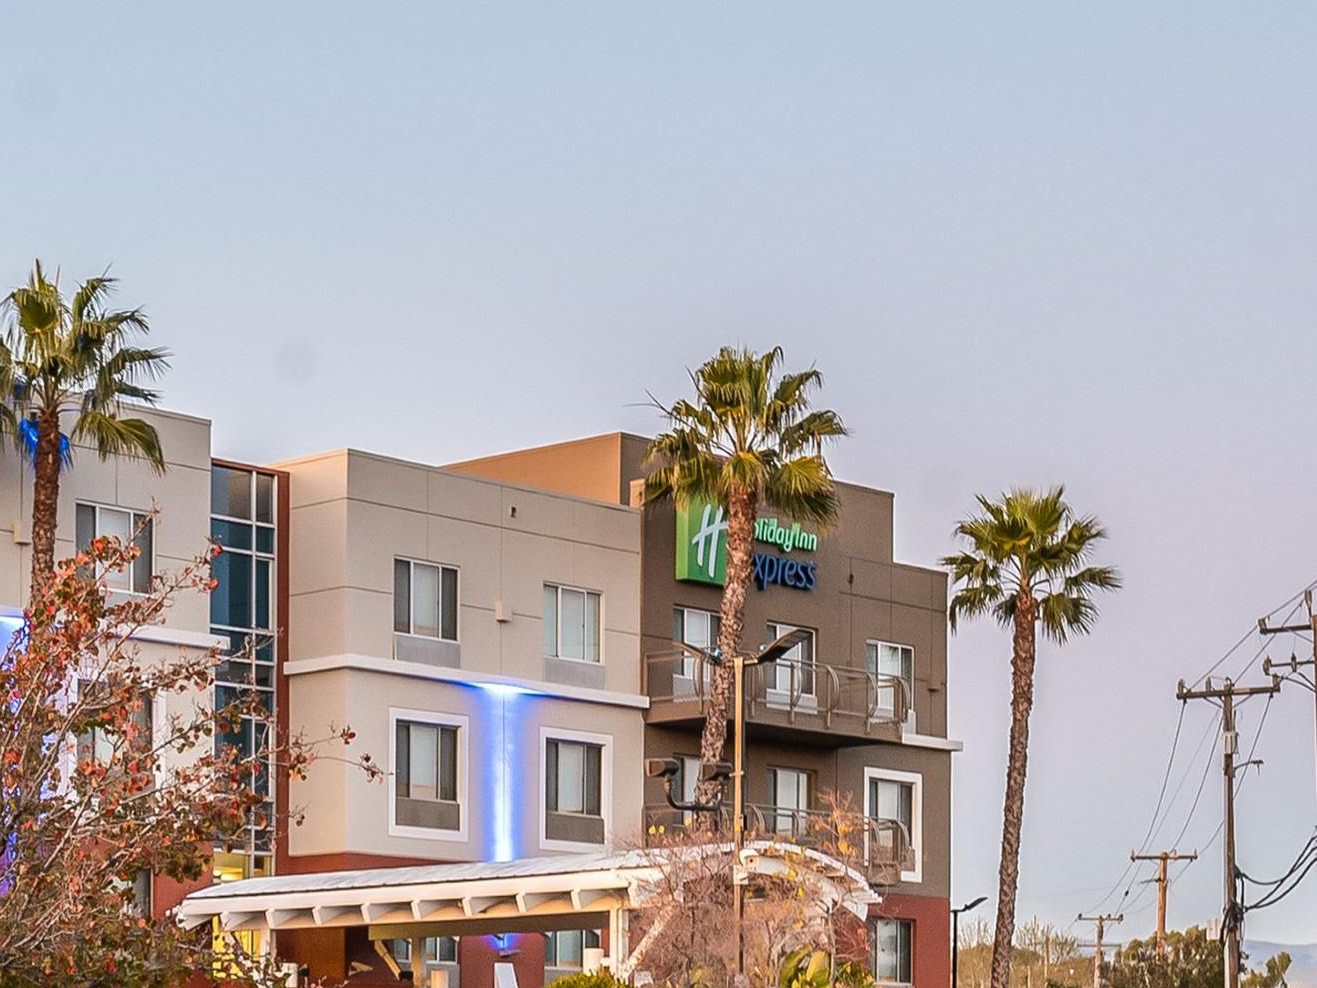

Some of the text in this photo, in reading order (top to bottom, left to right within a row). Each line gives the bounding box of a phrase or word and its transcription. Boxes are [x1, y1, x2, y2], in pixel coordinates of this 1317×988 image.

[691, 503, 729, 578] H
[753, 516, 818, 553] liday Inn
[753, 553, 817, 593] xpress
